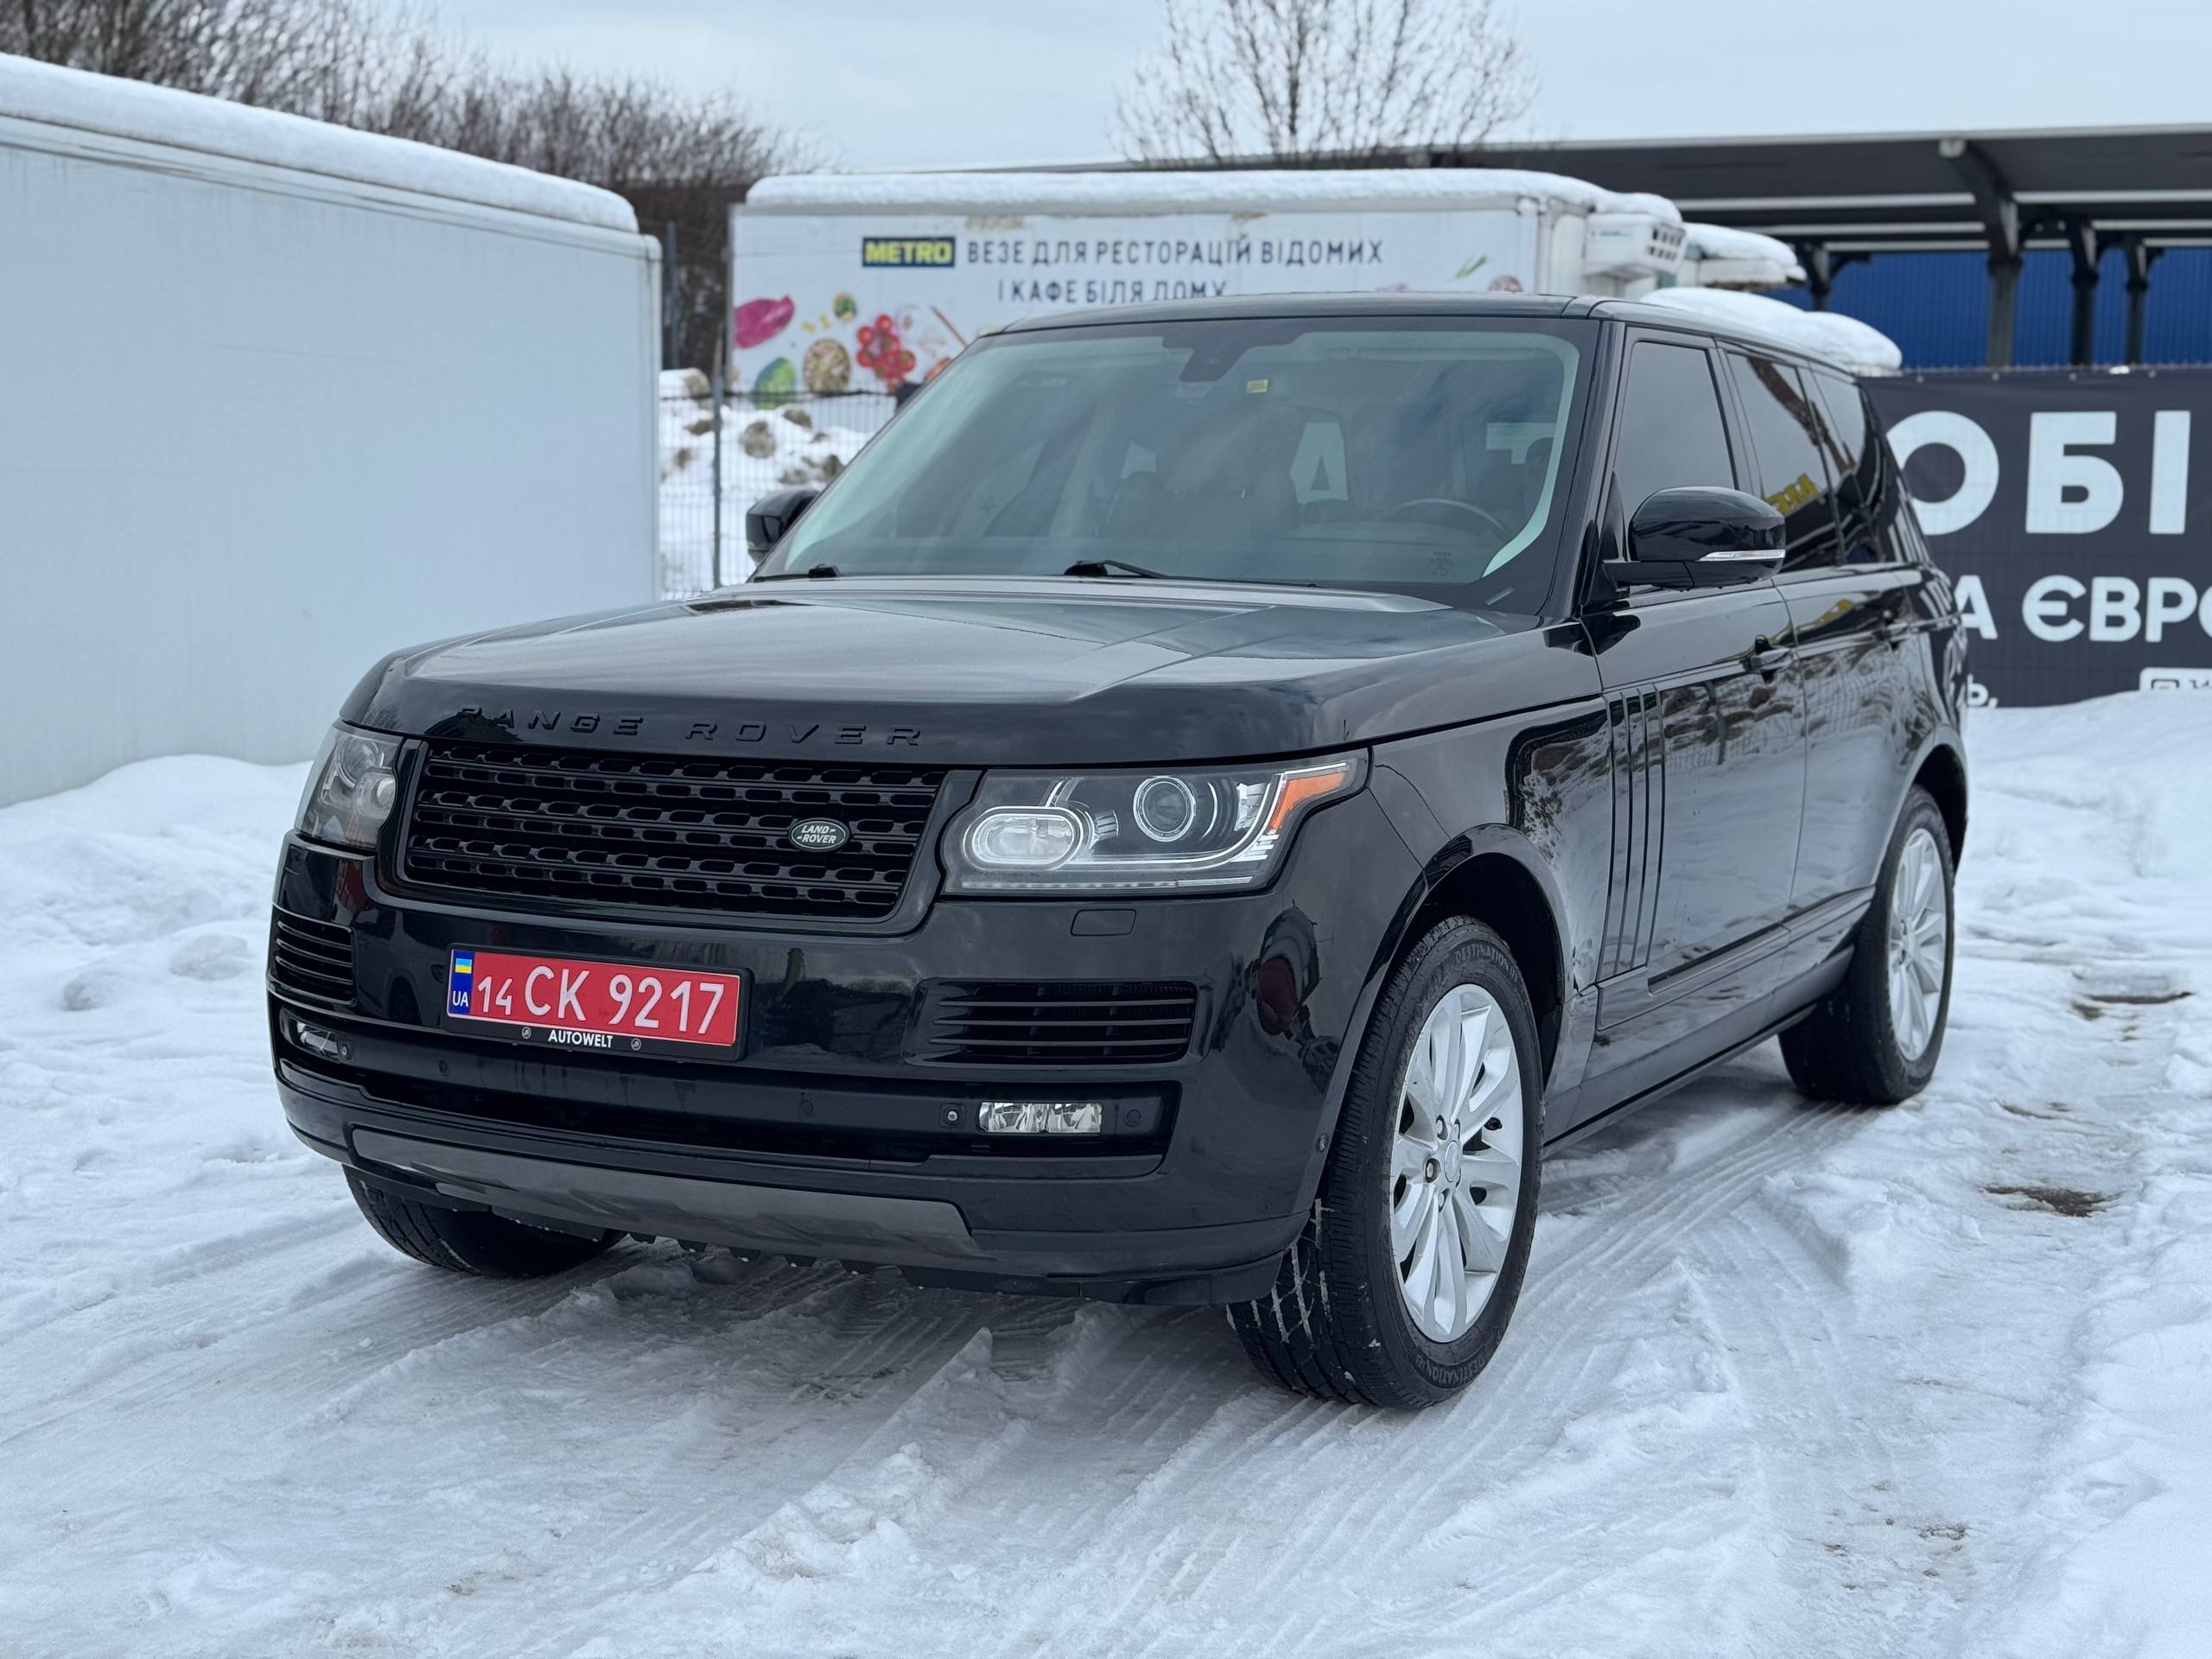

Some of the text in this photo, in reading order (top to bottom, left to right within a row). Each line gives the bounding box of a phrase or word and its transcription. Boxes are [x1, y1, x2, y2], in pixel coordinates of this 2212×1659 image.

[864, 239, 953, 265] METRO
[967, 233, 1382, 266] ВЕЗЕ ДЛЯ РЕСТОРАЦІЙ ВІДОМИХ
[1012, 281, 1077, 303] КАФЕ
[1086, 281, 1143, 304] БІЛЯ
[2022, 575, 2212, 642] ЄВР
[456, 704, 923, 747] RANGE ROVER
[800, 834, 837, 844] ROVER
[801, 825, 830, 835] LAND
[452, 990, 469, 1008] UA
[477, 965, 726, 1035] 14 CK 9217
[548, 1029, 613, 1049] AUTOWELT
